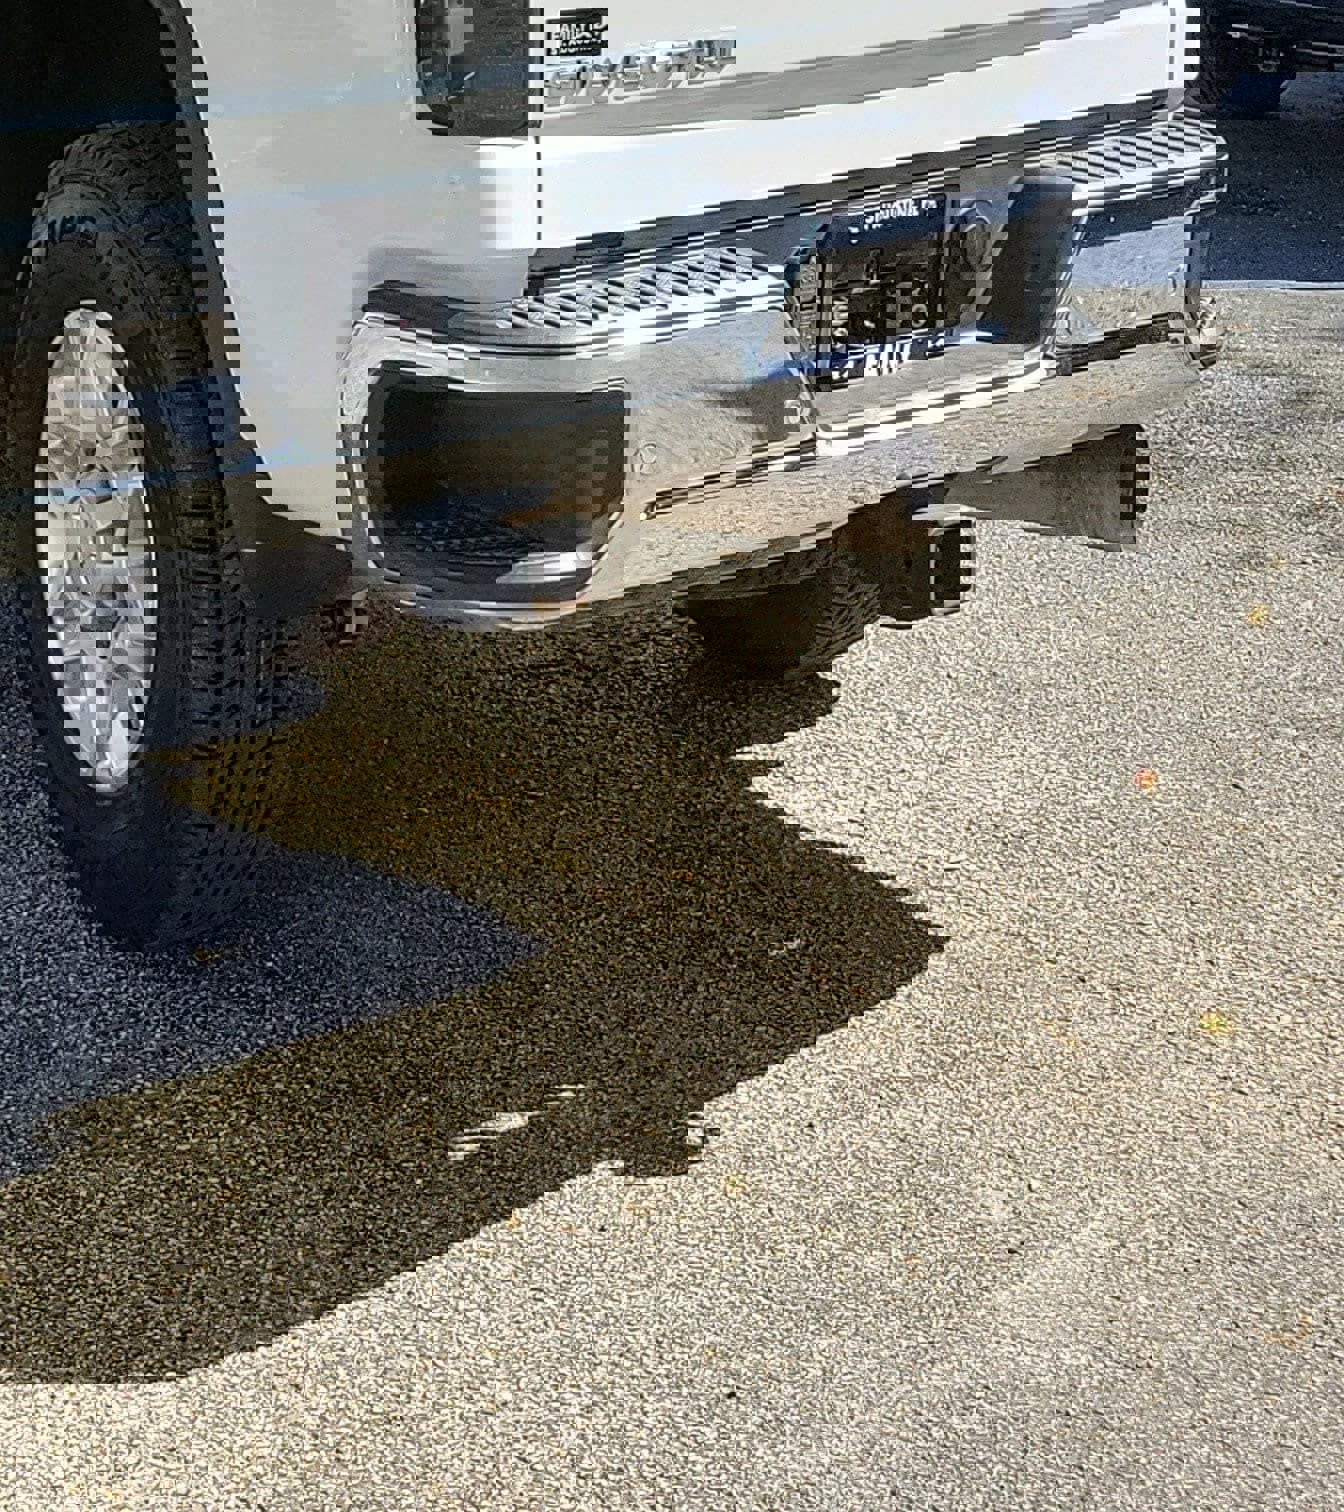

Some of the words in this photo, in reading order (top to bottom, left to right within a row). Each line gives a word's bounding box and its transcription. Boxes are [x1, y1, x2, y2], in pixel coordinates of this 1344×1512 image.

[385, 215, 406, 234] ST.
[408, 204, 486, 229] AUGUSTINE,
[489, 201, 503, 219] FL
[385, 342, 483, 384] FAMILY
